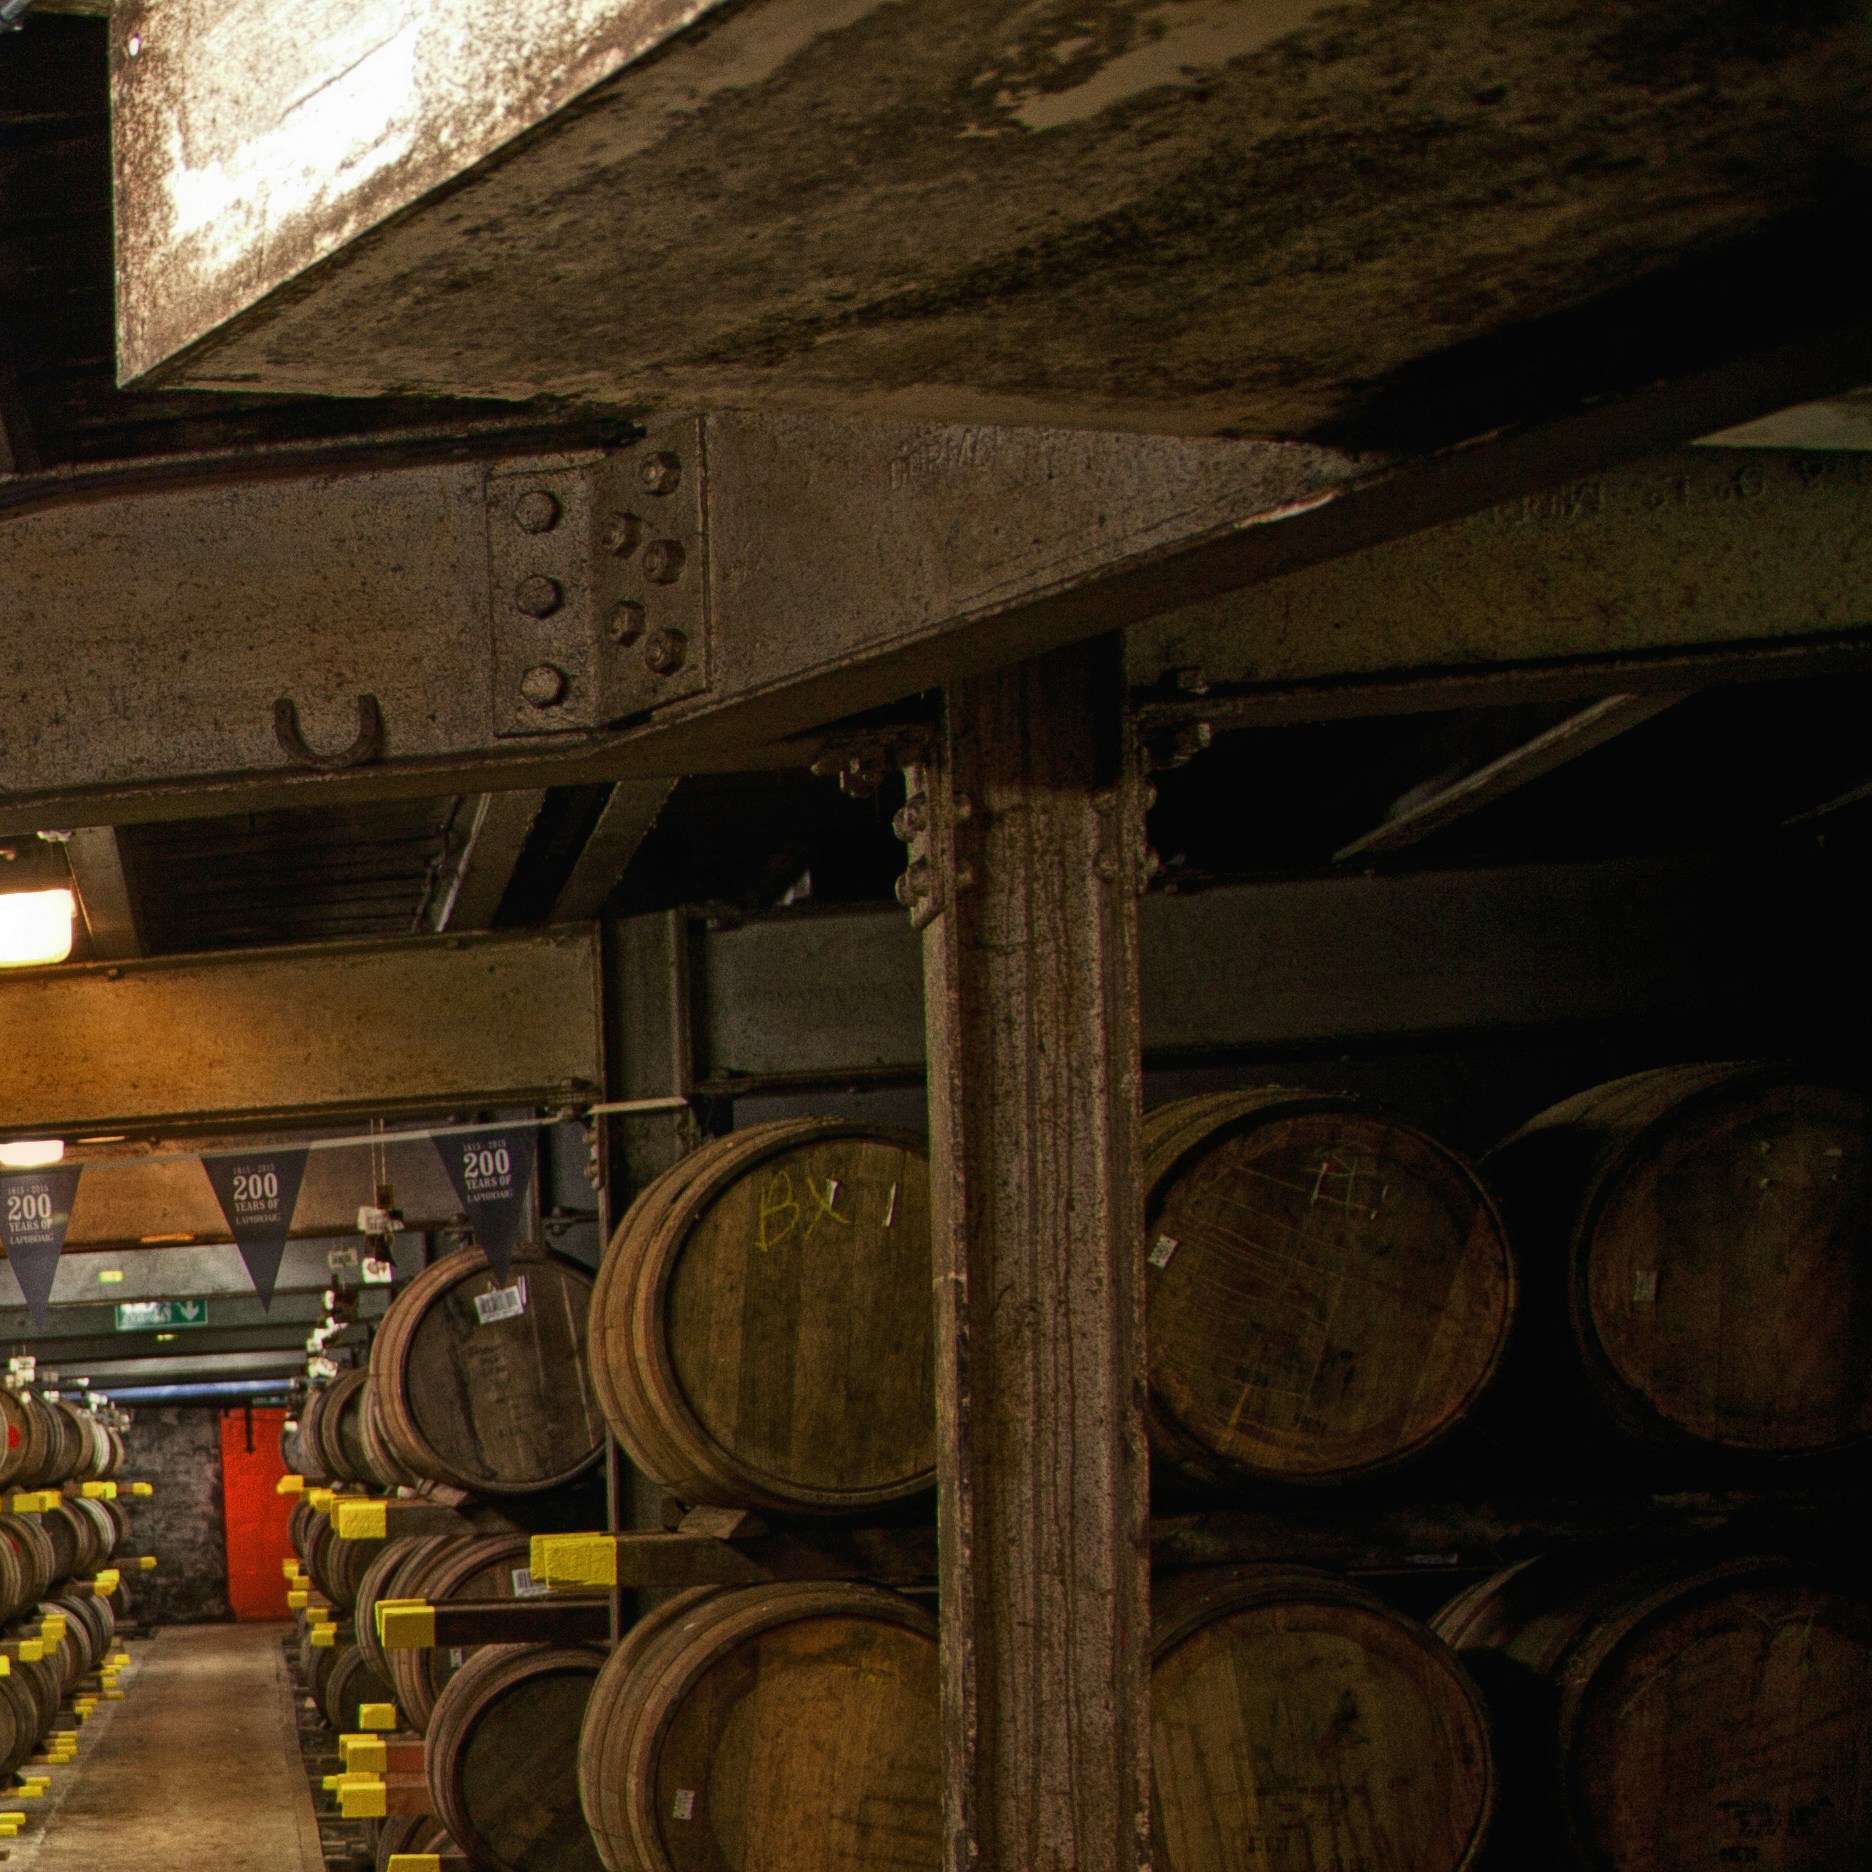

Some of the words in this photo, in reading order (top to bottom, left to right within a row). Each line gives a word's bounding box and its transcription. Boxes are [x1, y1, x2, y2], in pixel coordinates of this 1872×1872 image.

[463, 1148, 511, 1179] 200
[233, 1172, 278, 1201] 200
[466, 1178, 497, 1190] YEARS
[499, 1174, 512, 1187] OF
[7, 1193, 52, 1221] 200
[235, 1201, 266, 1212] YEARS
[267, 1199, 280, 1209] OF
[9, 1220, 40, 1233] YEARS
[40, 1219, 53, 1230] OF
